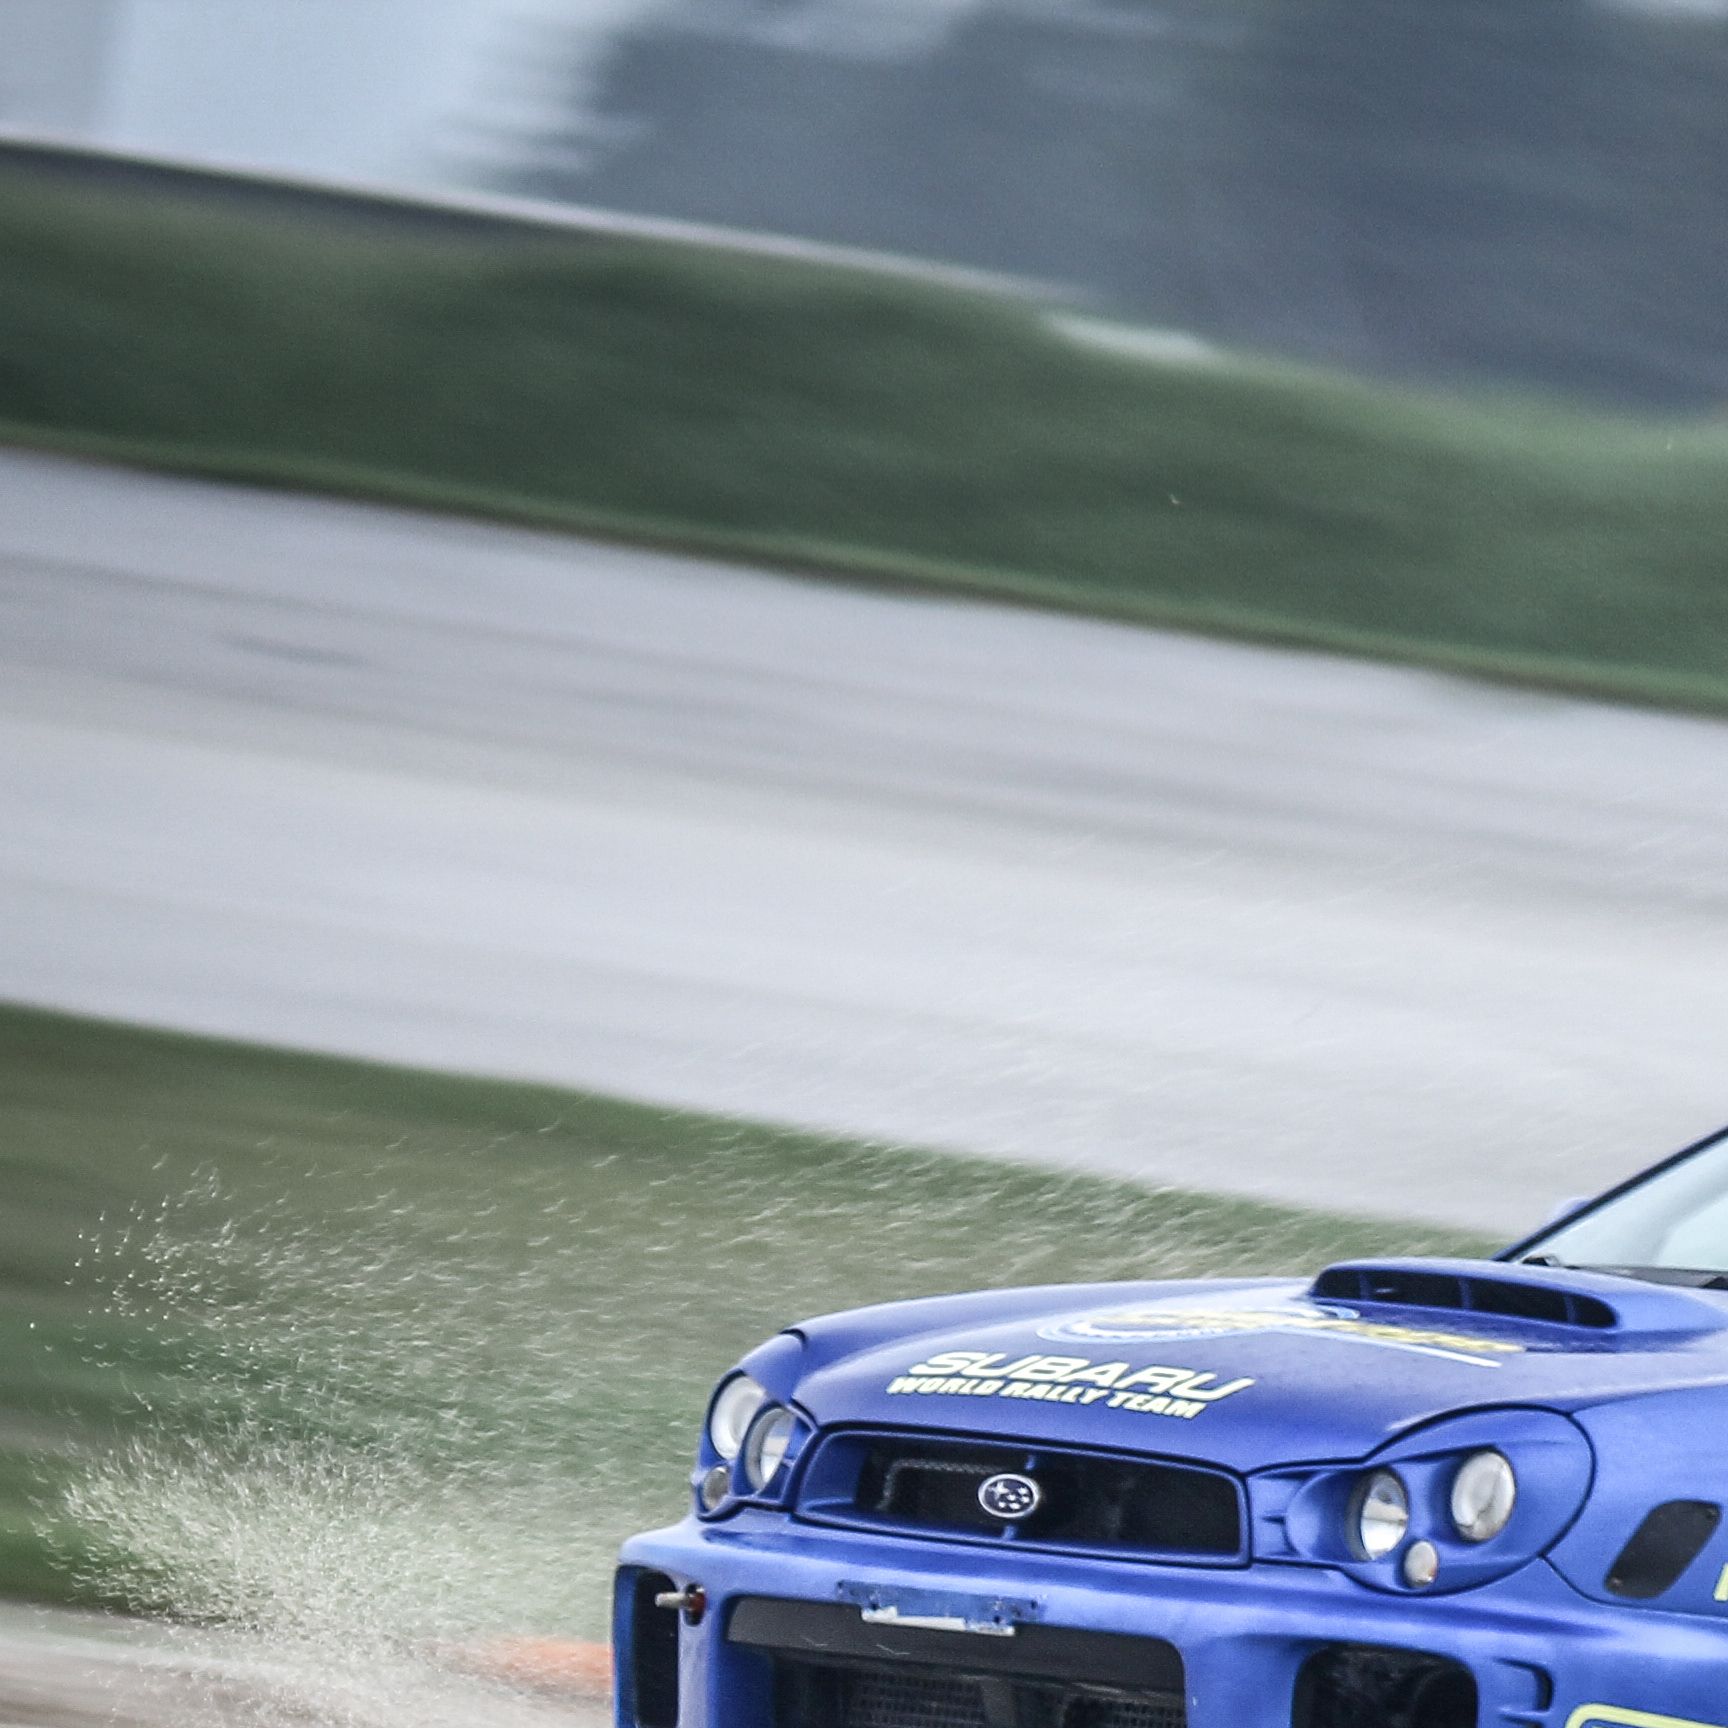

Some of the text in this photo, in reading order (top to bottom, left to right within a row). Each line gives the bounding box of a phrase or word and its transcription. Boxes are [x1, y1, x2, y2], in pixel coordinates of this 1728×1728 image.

[886, 1375, 1208, 1420] WORLD RALLY TEAM
[908, 1351, 1256, 1401] SUBARU
